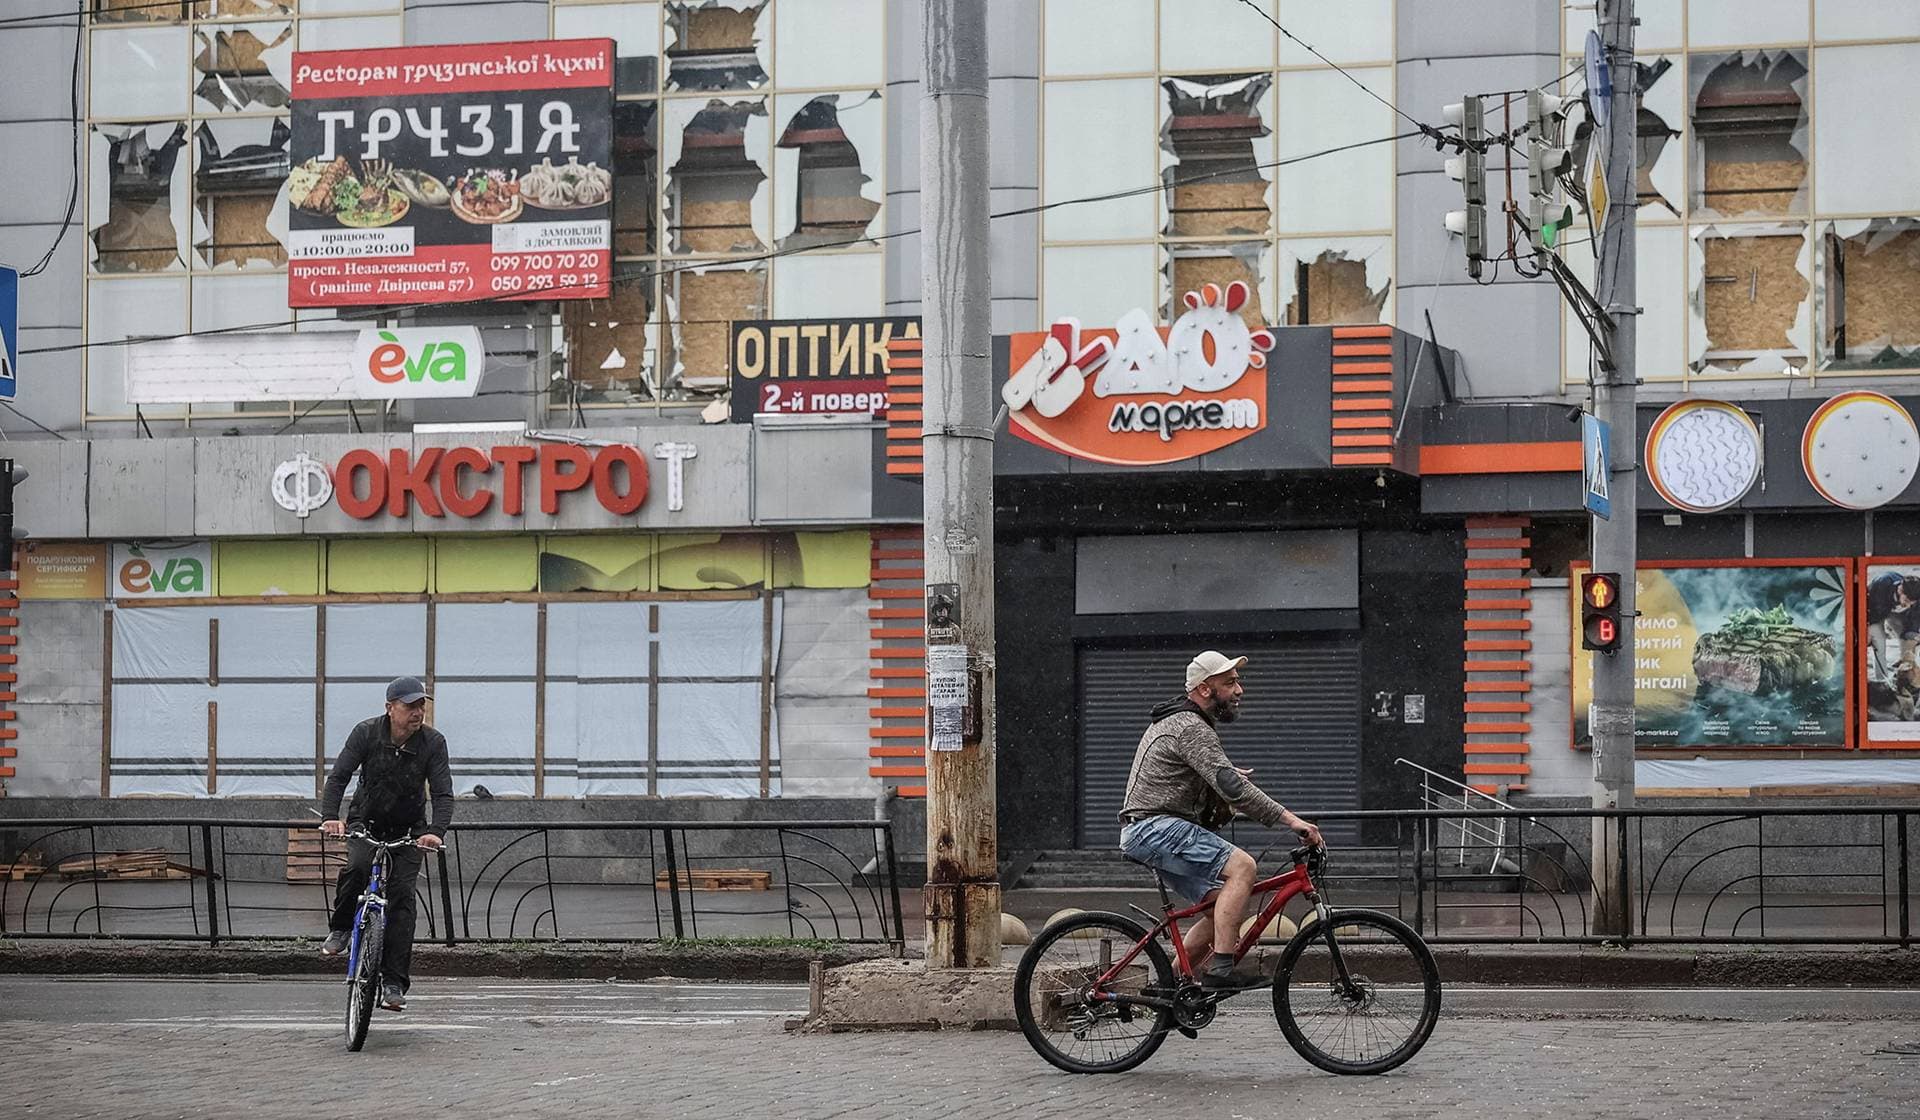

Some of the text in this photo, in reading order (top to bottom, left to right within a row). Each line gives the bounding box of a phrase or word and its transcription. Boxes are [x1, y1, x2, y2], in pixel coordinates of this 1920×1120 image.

[296, 51, 606, 85] Ресторан грузинської кухні
[316, 100, 581, 162] ГРУЗІЯ
[322, 232, 385, 244] працюємо
[541, 226, 602, 237] ЗАМОВЛЯЙ
[303, 245, 344, 257] 10:00
[347, 247, 362, 257] до
[365, 243, 410, 254] 20:00
[533, 237, 603, 248] ДОСТАВКОЮ
[293, 259, 470, 280] просп. Незалежності 57,
[491, 253, 599, 271] 099 700 70 20
[377, 278, 445, 294] Двірцева
[491, 274, 598, 292] 050 293 59 12
[764, 384, 804, 411] 2-й
[1109, 399, 1260, 441] маркет
[272, 441, 698, 519] ФОКСТРОТ
[36, 565, 88, 573] СЕРТИФІКАТ
